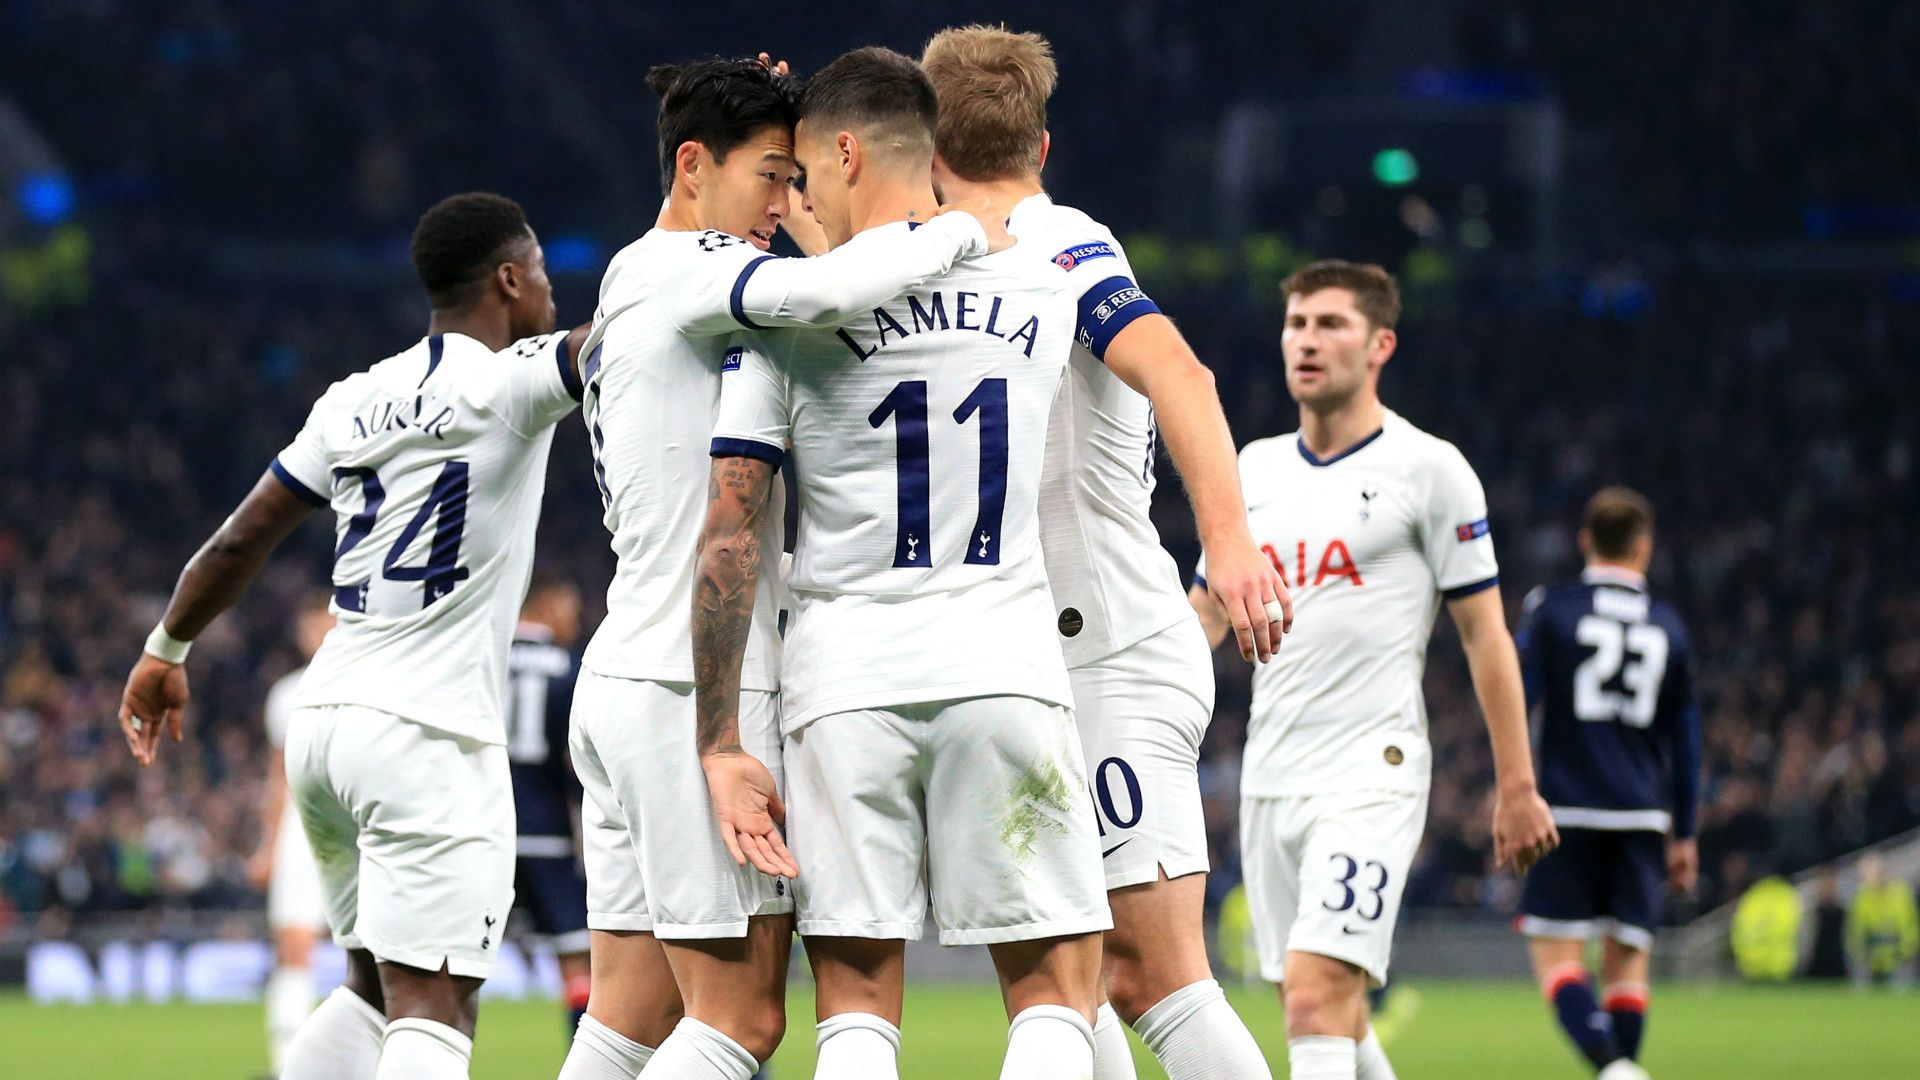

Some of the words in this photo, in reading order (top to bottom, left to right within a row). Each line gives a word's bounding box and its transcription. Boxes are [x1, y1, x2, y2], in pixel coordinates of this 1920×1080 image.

[1071, 245, 1114, 260] RESPECT
[836, 291, 1039, 362] LAMELA
[1110, 289, 1148, 307] RESP
[867, 377, 1009, 568] 11
[331, 460, 470, 613] 24
[1573, 615, 1670, 728] 23
[1087, 756, 1143, 836] 0
[1322, 852, 1389, 922] 33
